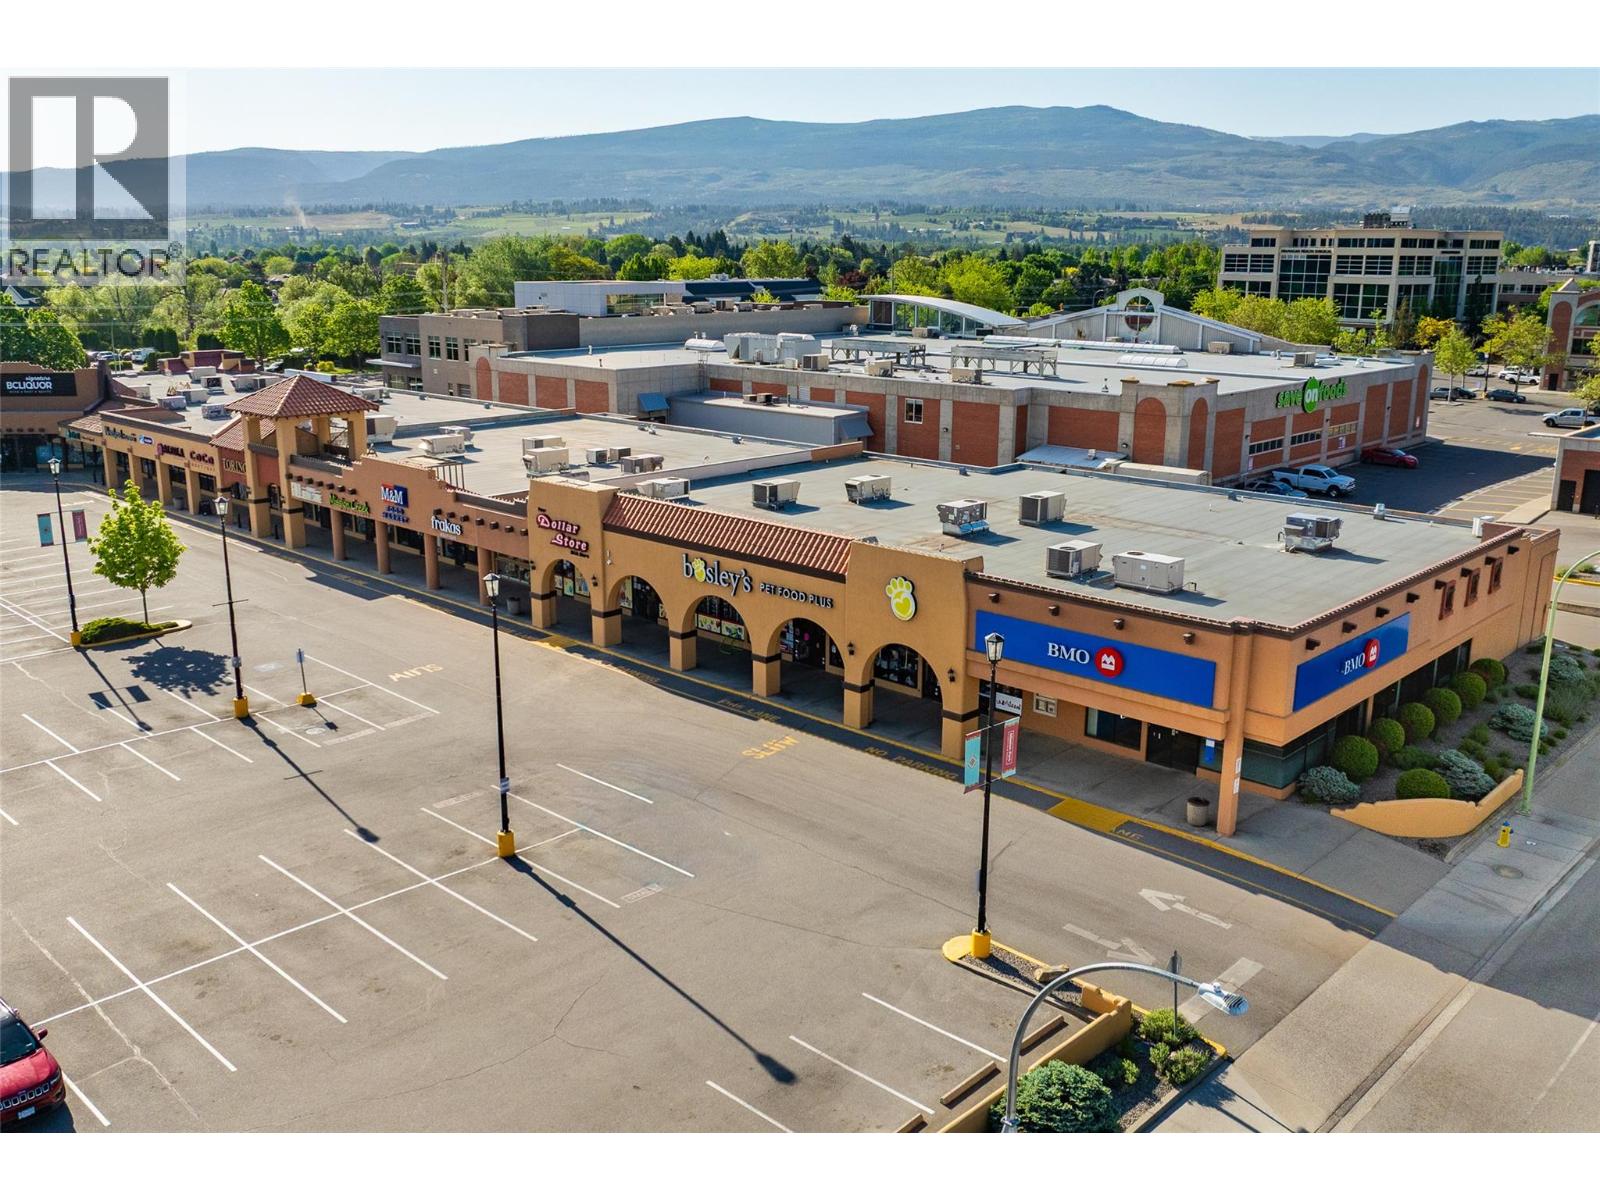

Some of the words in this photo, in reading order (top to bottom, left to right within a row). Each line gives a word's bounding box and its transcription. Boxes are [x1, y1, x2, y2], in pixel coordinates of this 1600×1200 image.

[1275, 389, 1303, 409] save
[1304, 388, 1319, 403] on
[381, 487, 404, 505] M&M
[431, 515, 463, 536] frakas
[537, 513, 579, 534] Dollar
[551, 533, 588, 551] Store
[682, 553, 753, 597] bosley's
[759, 581, 776, 596] PET
[777, 585, 807, 603] FOOD
[808, 592, 835, 609] PLUS
[1047, 642, 1091, 666] BMO
[1343, 651, 1367, 676] BMO
[864, 746, 890, 758] NO
[892, 755, 960, 781] PARKING
